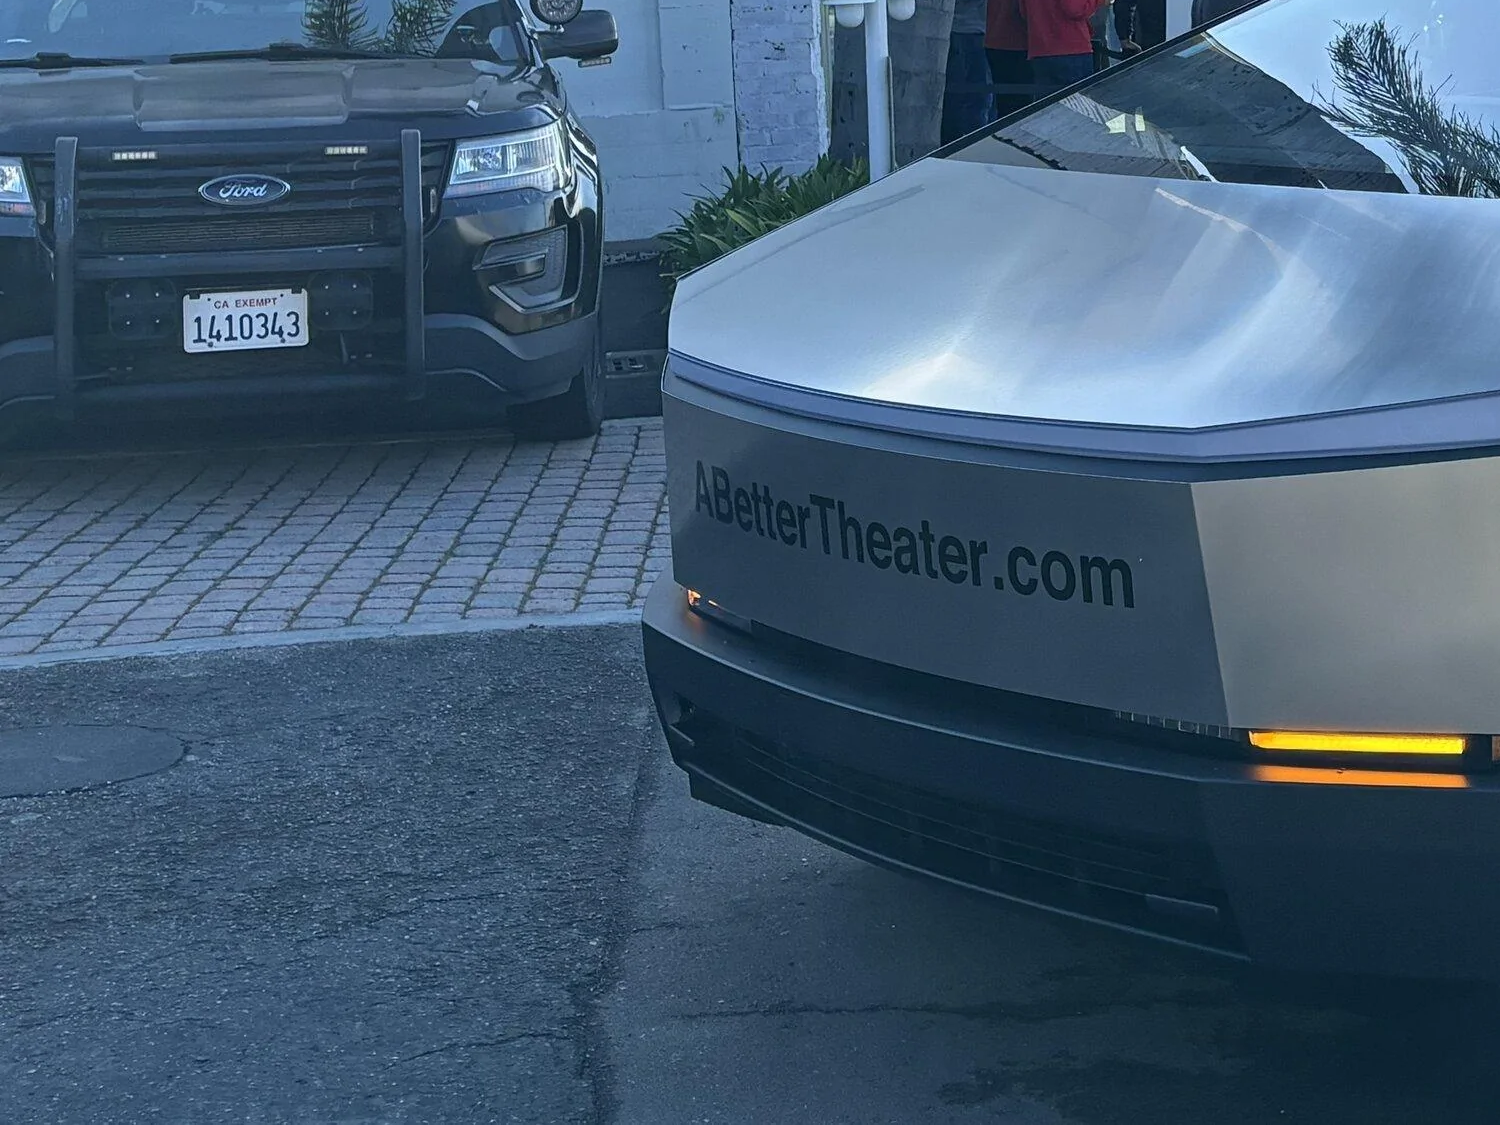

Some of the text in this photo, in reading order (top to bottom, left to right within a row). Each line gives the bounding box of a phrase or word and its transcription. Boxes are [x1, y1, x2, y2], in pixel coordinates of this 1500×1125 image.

[218, 181, 268, 199] Ford
[213, 296, 279, 310] CA EXEMPT
[191, 310, 301, 345] 1410343
[695, 460, 1136, 609] ABetterTheater.com
